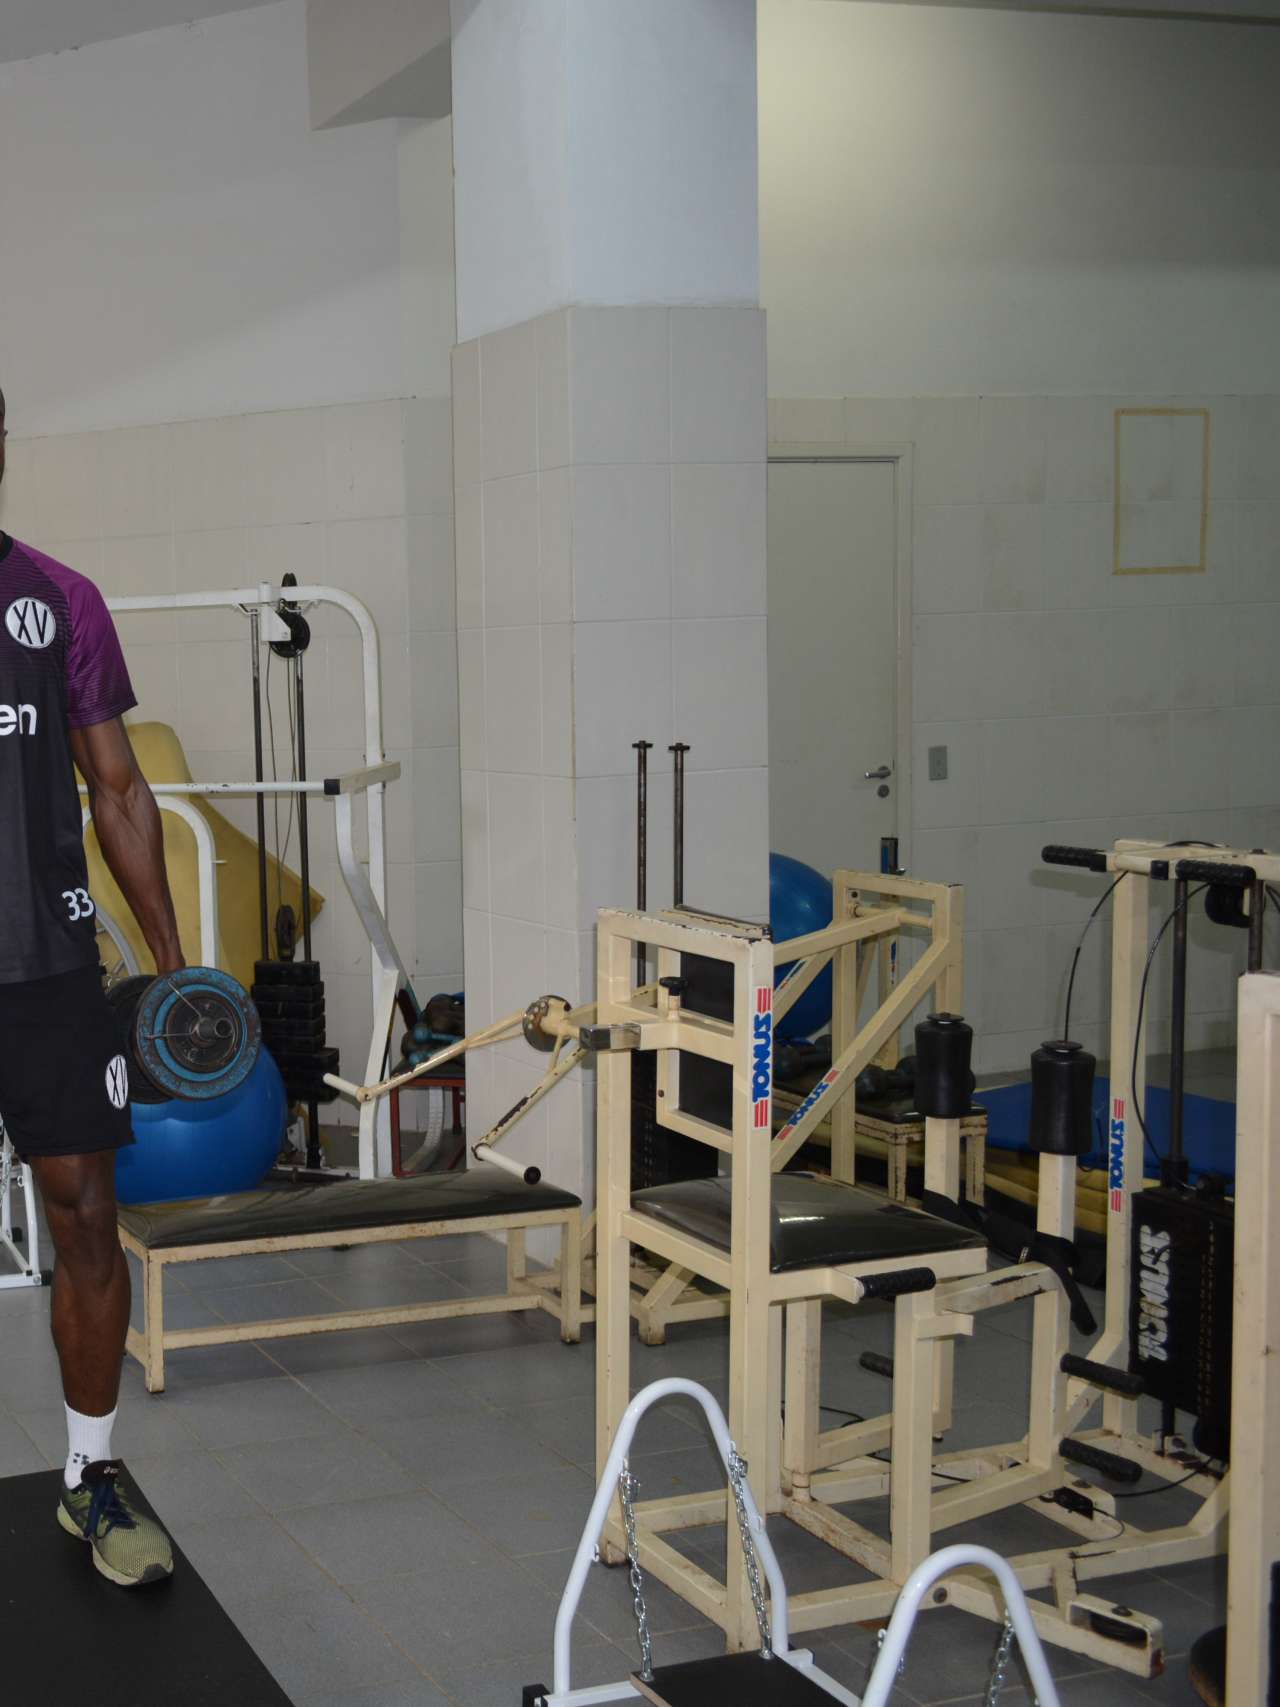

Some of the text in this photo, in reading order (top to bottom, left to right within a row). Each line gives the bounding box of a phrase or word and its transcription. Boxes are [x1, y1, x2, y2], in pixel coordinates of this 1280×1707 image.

[12, 600, 48, 645] XV
[62, 887, 94, 921] 33
[108, 1057, 127, 1106] XV
[752, 1012, 771, 1103] TONUS
[787, 1082, 829, 1126] TONUS
[1109, 1119, 1125, 1190] TONUS
[1138, 1224, 1171, 1361] TONUS
